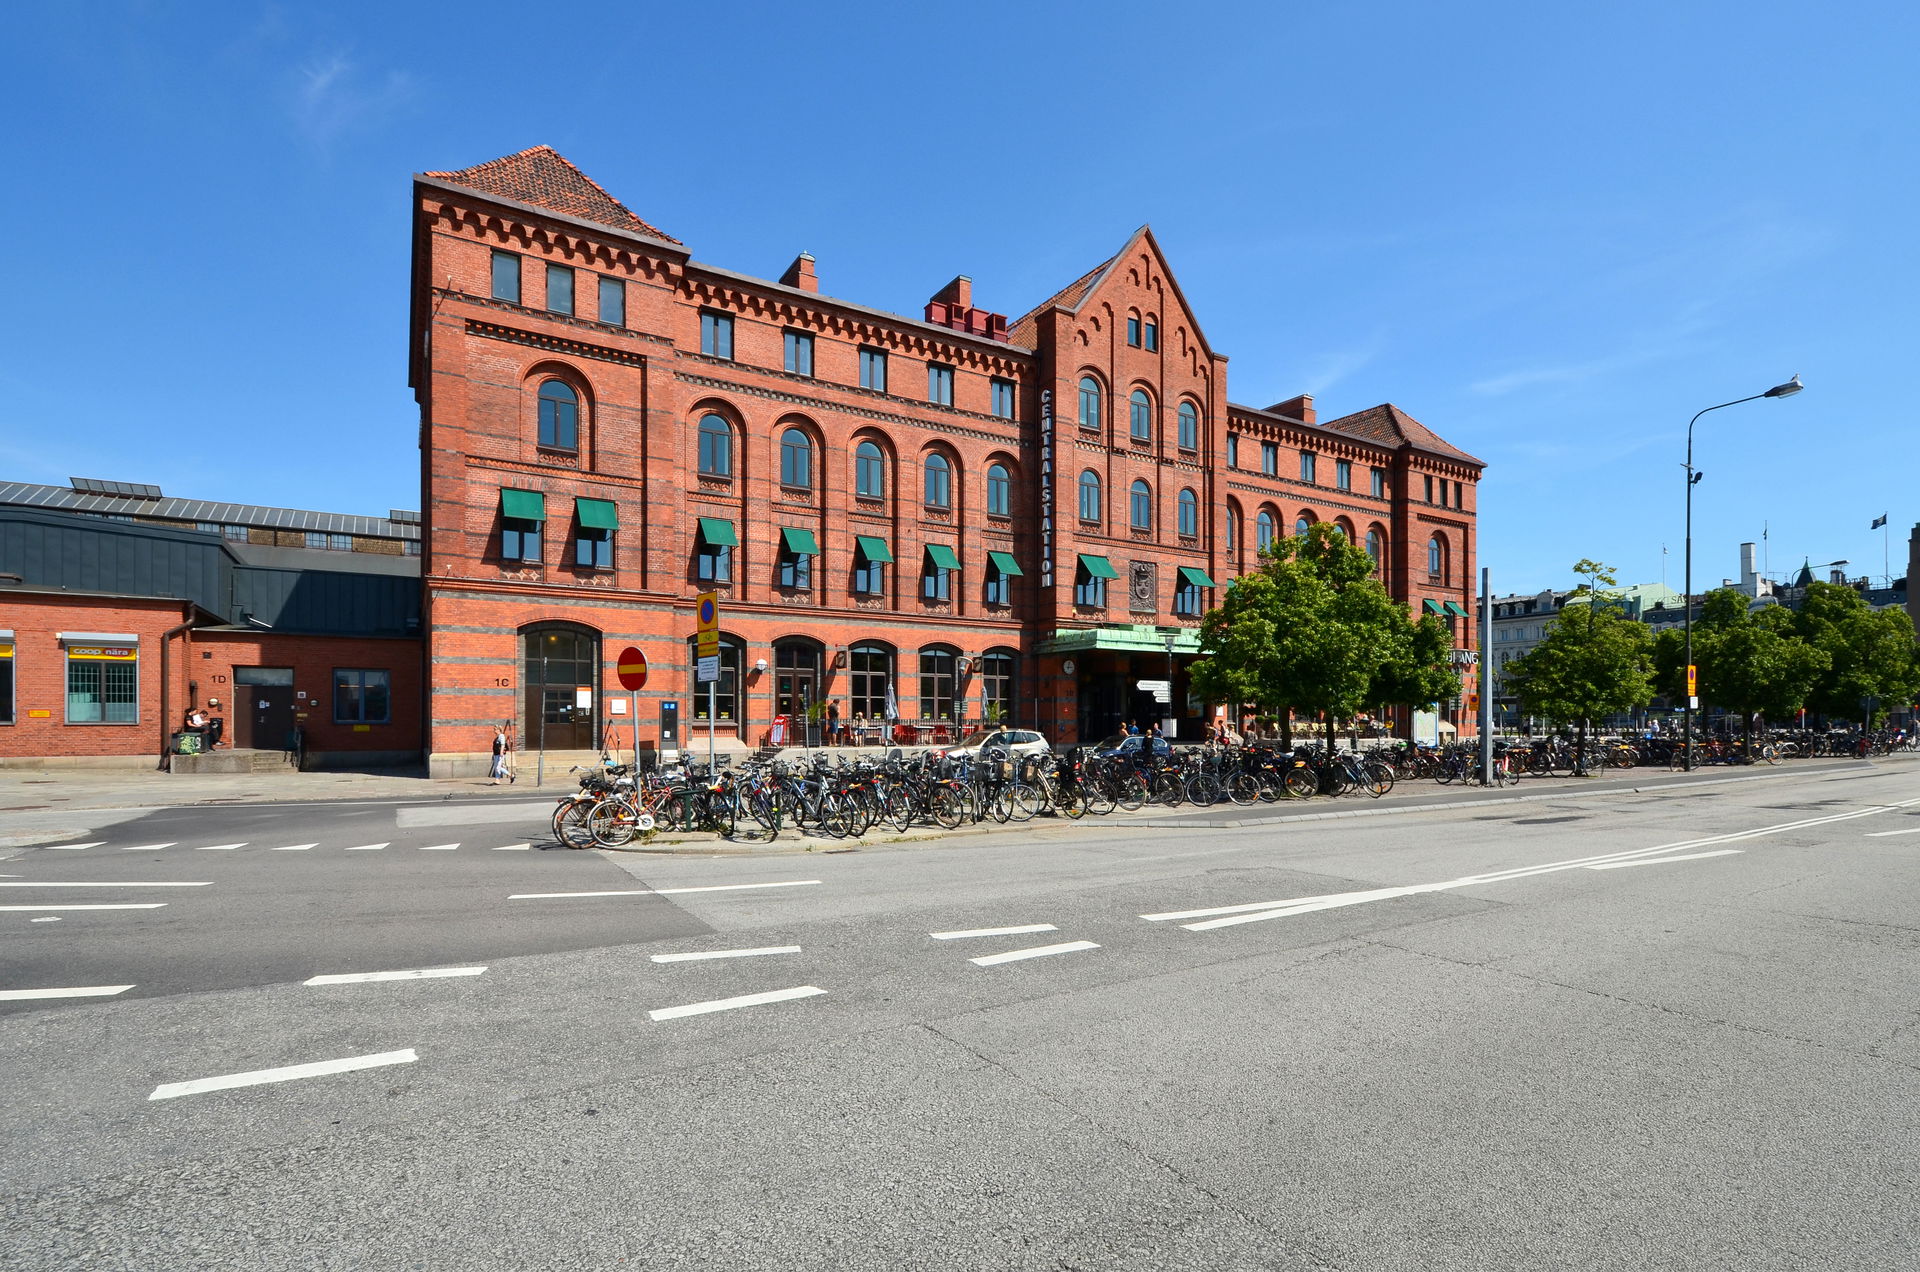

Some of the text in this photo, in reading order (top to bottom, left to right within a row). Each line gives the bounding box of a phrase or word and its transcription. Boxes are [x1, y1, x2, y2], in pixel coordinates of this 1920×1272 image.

[1041, 389, 1053, 588] CENTRALSTATION
[73, 648, 128, 656] coop nära
[211, 675, 227, 684] 1D
[495, 678, 509, 687] 1C
